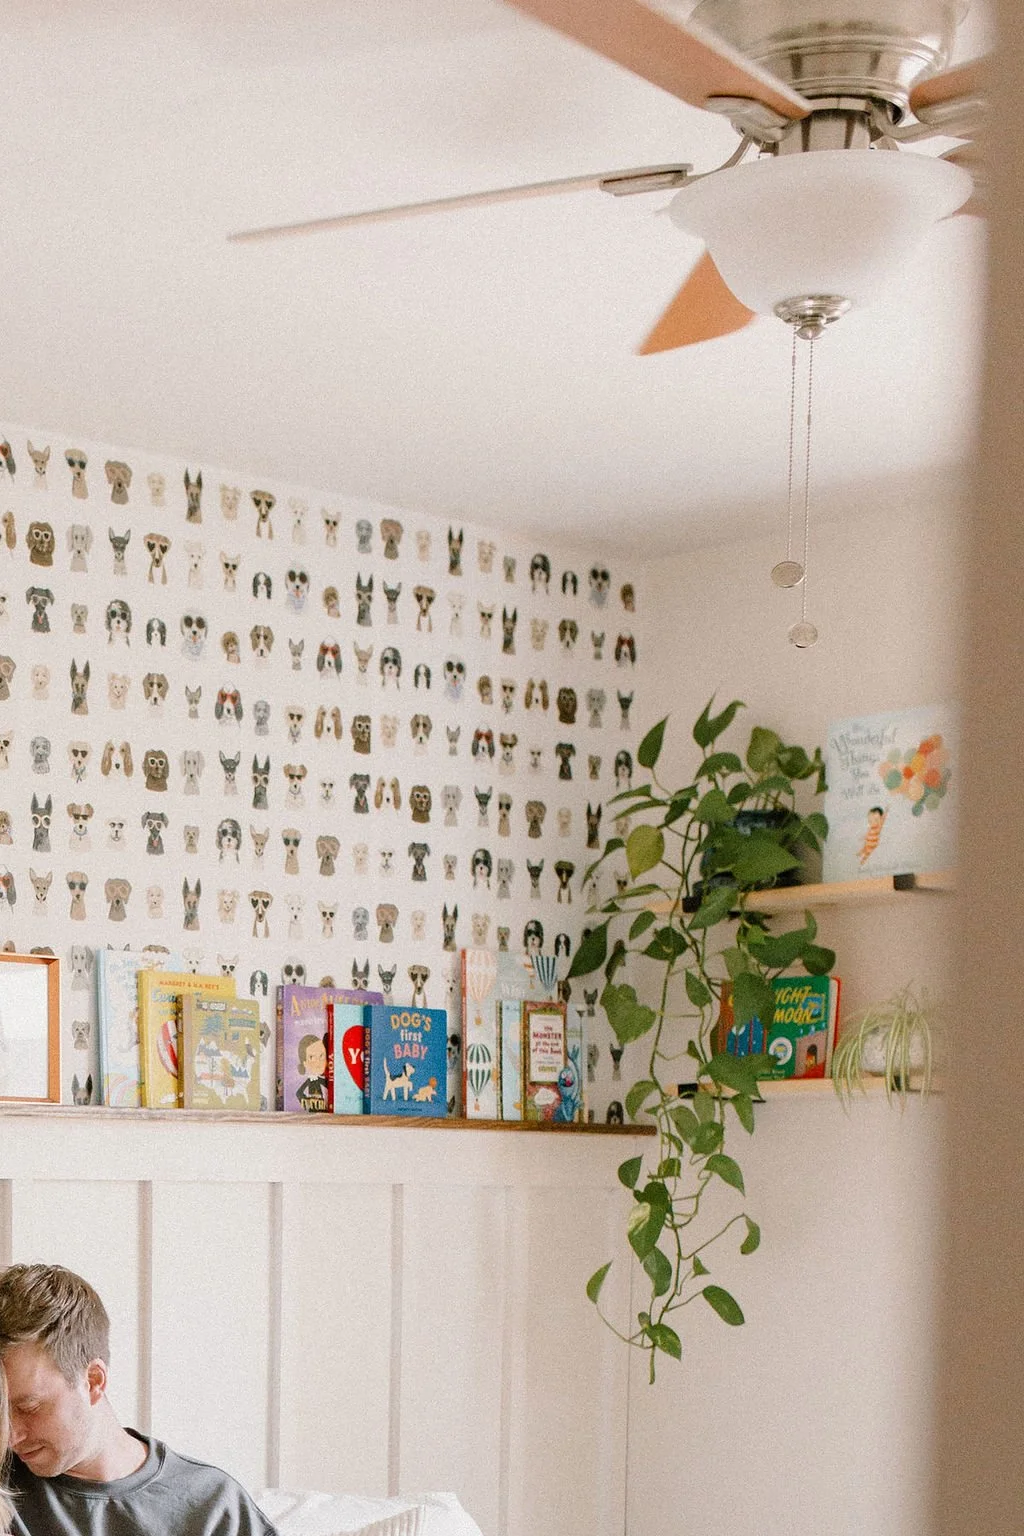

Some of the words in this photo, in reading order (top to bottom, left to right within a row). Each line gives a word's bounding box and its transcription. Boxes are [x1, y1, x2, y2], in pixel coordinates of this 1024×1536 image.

[390, 1011, 432, 1031] DOG'S
[773, 1007, 812, 1026] MOON
[400, 1029, 423, 1042] first
[393, 1043, 428, 1060] BABY
